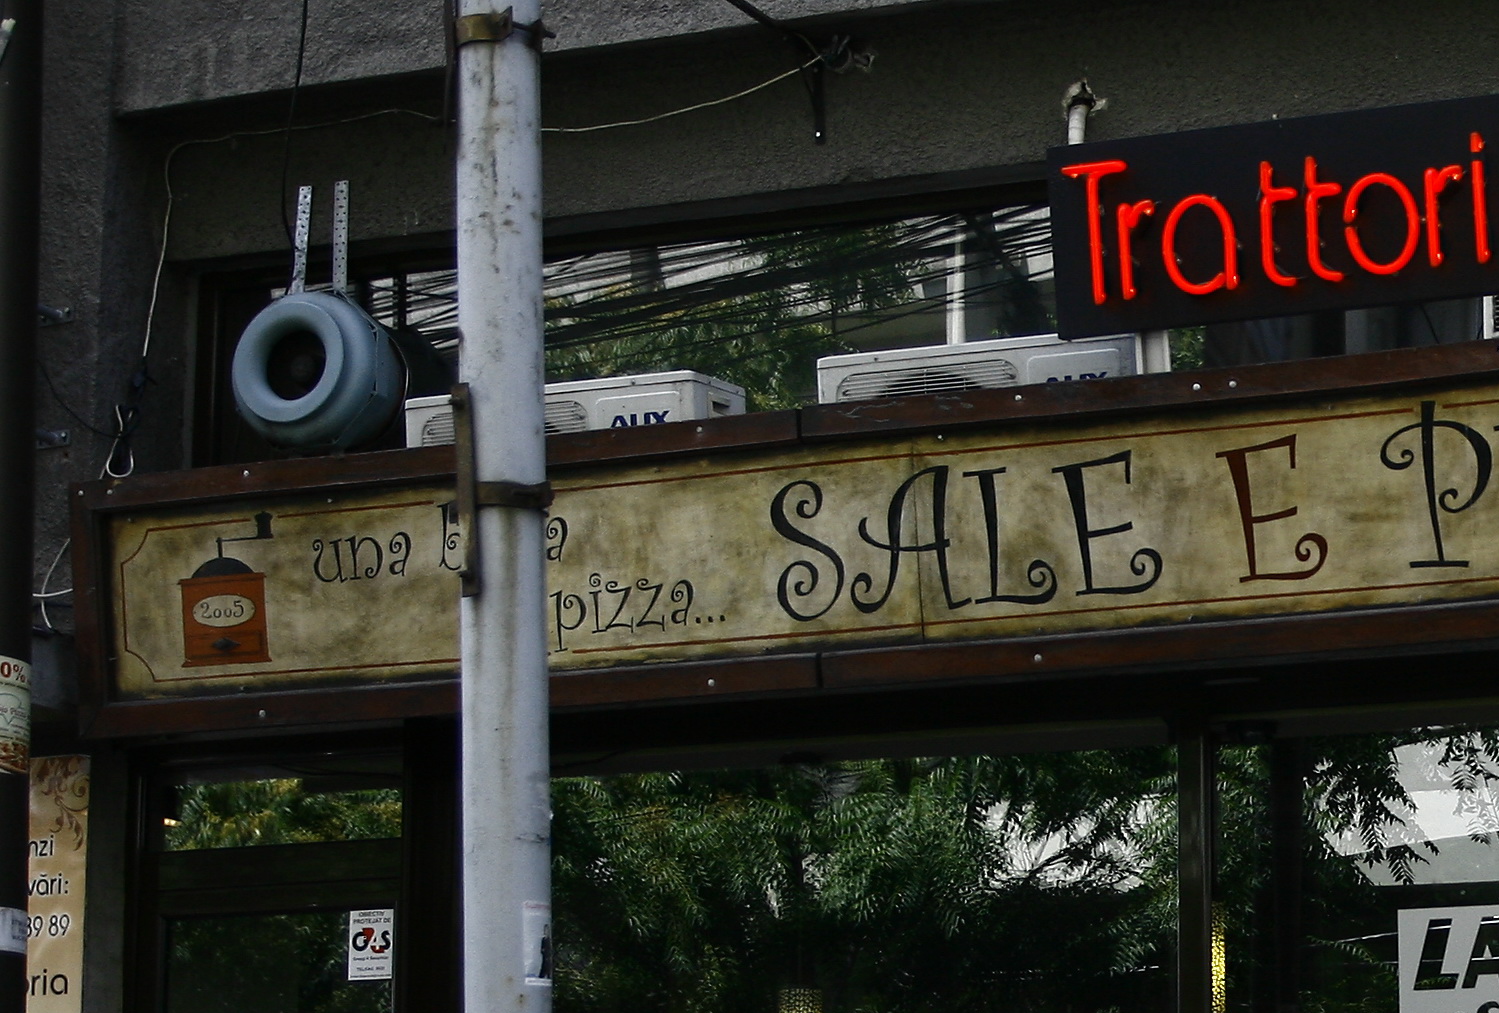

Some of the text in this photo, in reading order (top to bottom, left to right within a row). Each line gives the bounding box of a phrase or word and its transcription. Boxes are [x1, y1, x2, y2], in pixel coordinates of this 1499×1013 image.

[770, 451, 1163, 622] SALE
[1216, 434, 1328, 584] E
[312, 532, 412, 584] una
[200, 600, 245, 619] 2005
[48, 914, 70, 937] 89
